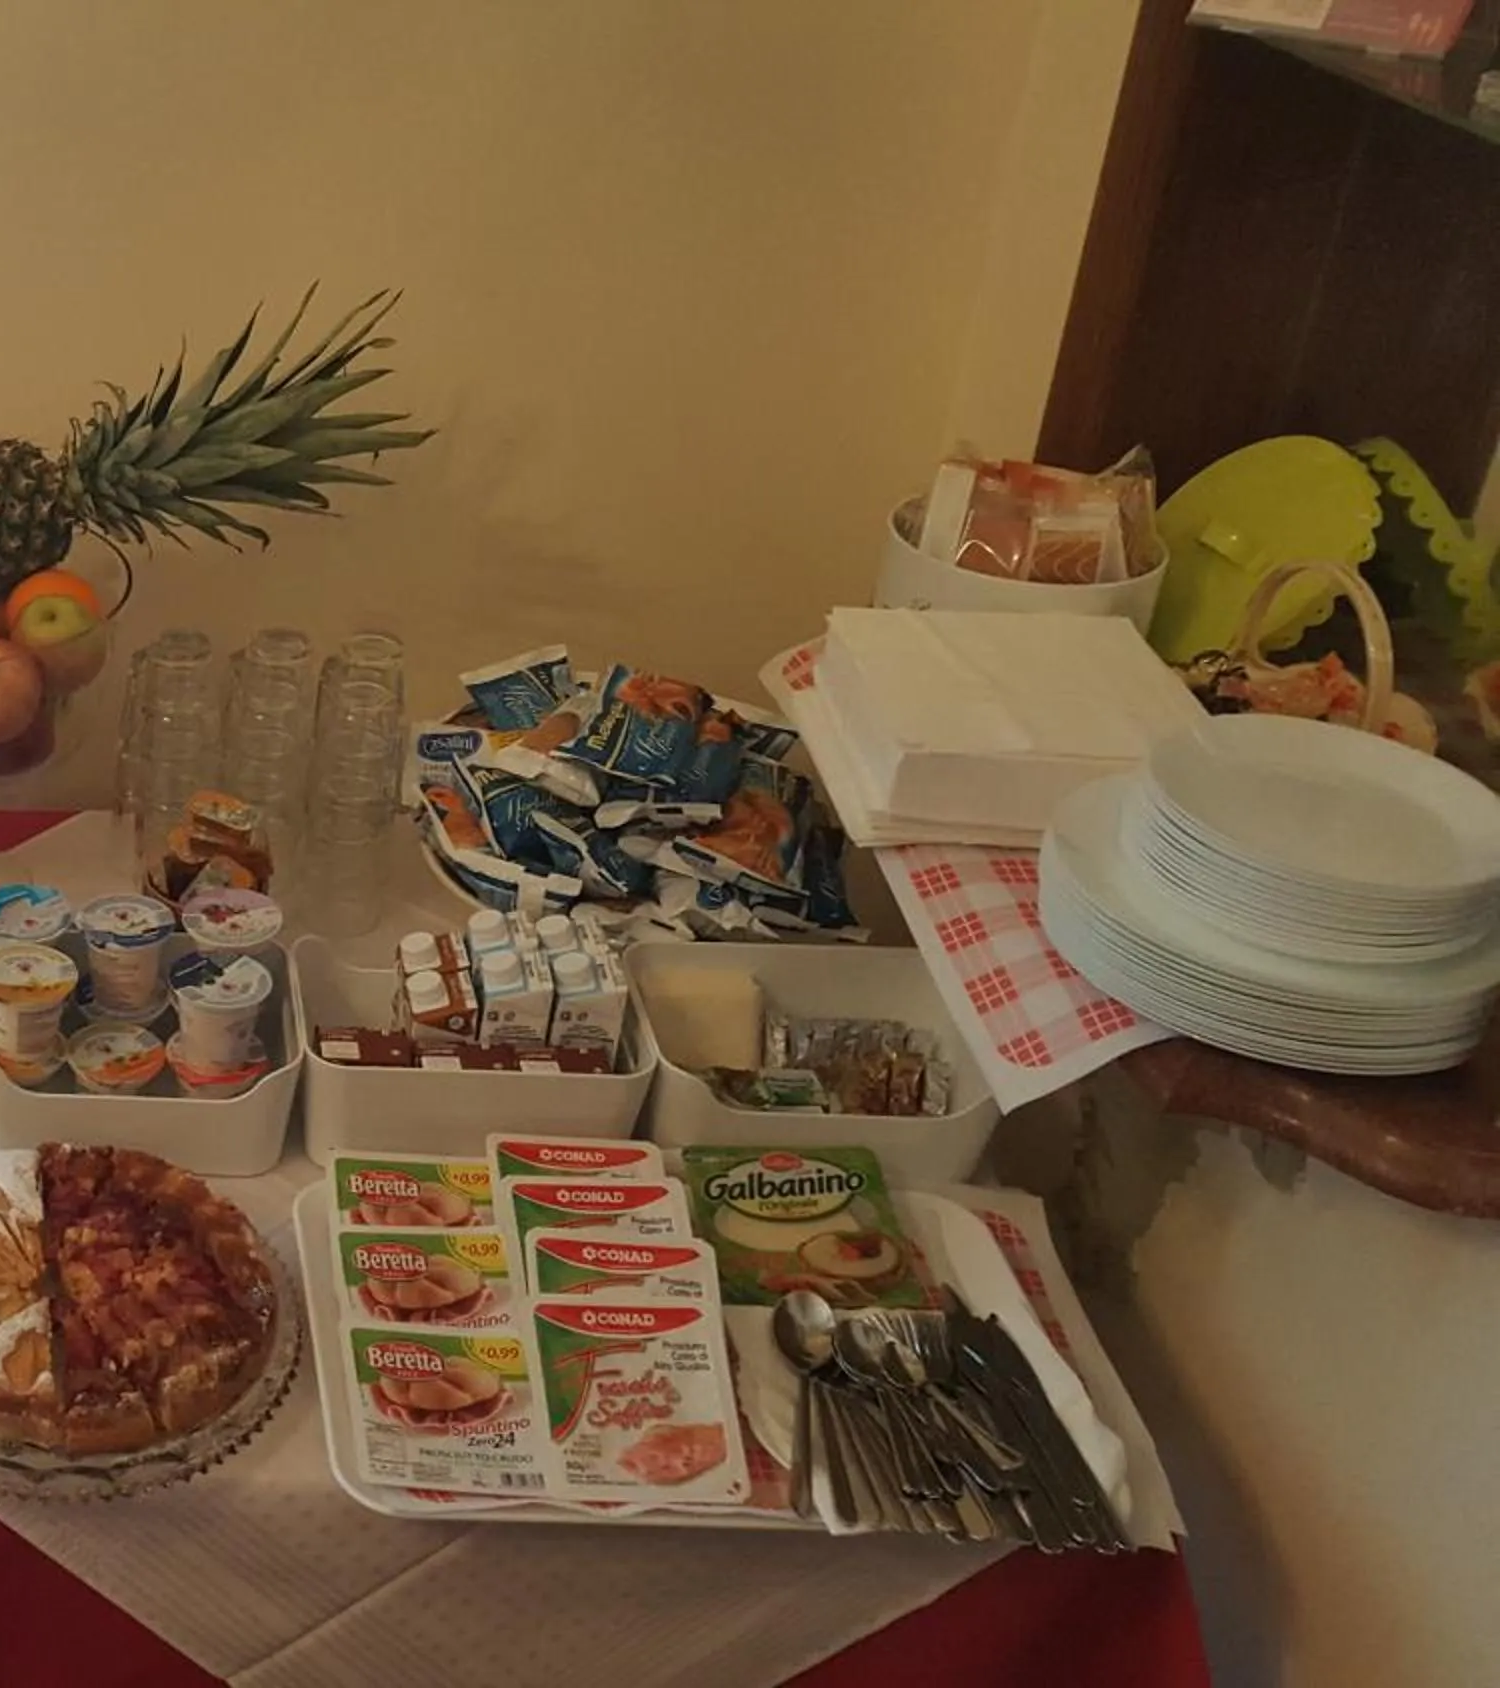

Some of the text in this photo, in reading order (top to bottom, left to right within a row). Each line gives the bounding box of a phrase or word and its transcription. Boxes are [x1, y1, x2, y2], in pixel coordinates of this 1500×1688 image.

[551, 1150, 606, 1163] CONAD
[350, 1175, 420, 1197] Beretta
[704, 1168, 864, 1201] Galbanino
[570, 1191, 625, 1203] CONAD
[355, 1249, 427, 1272] Beretta
[597, 1247, 655, 1263] CONAD
[597, 1311, 656, 1326] CONAD
[367, 1347, 444, 1372] Beretta
[450, 1417, 531, 1439] Spuntino
